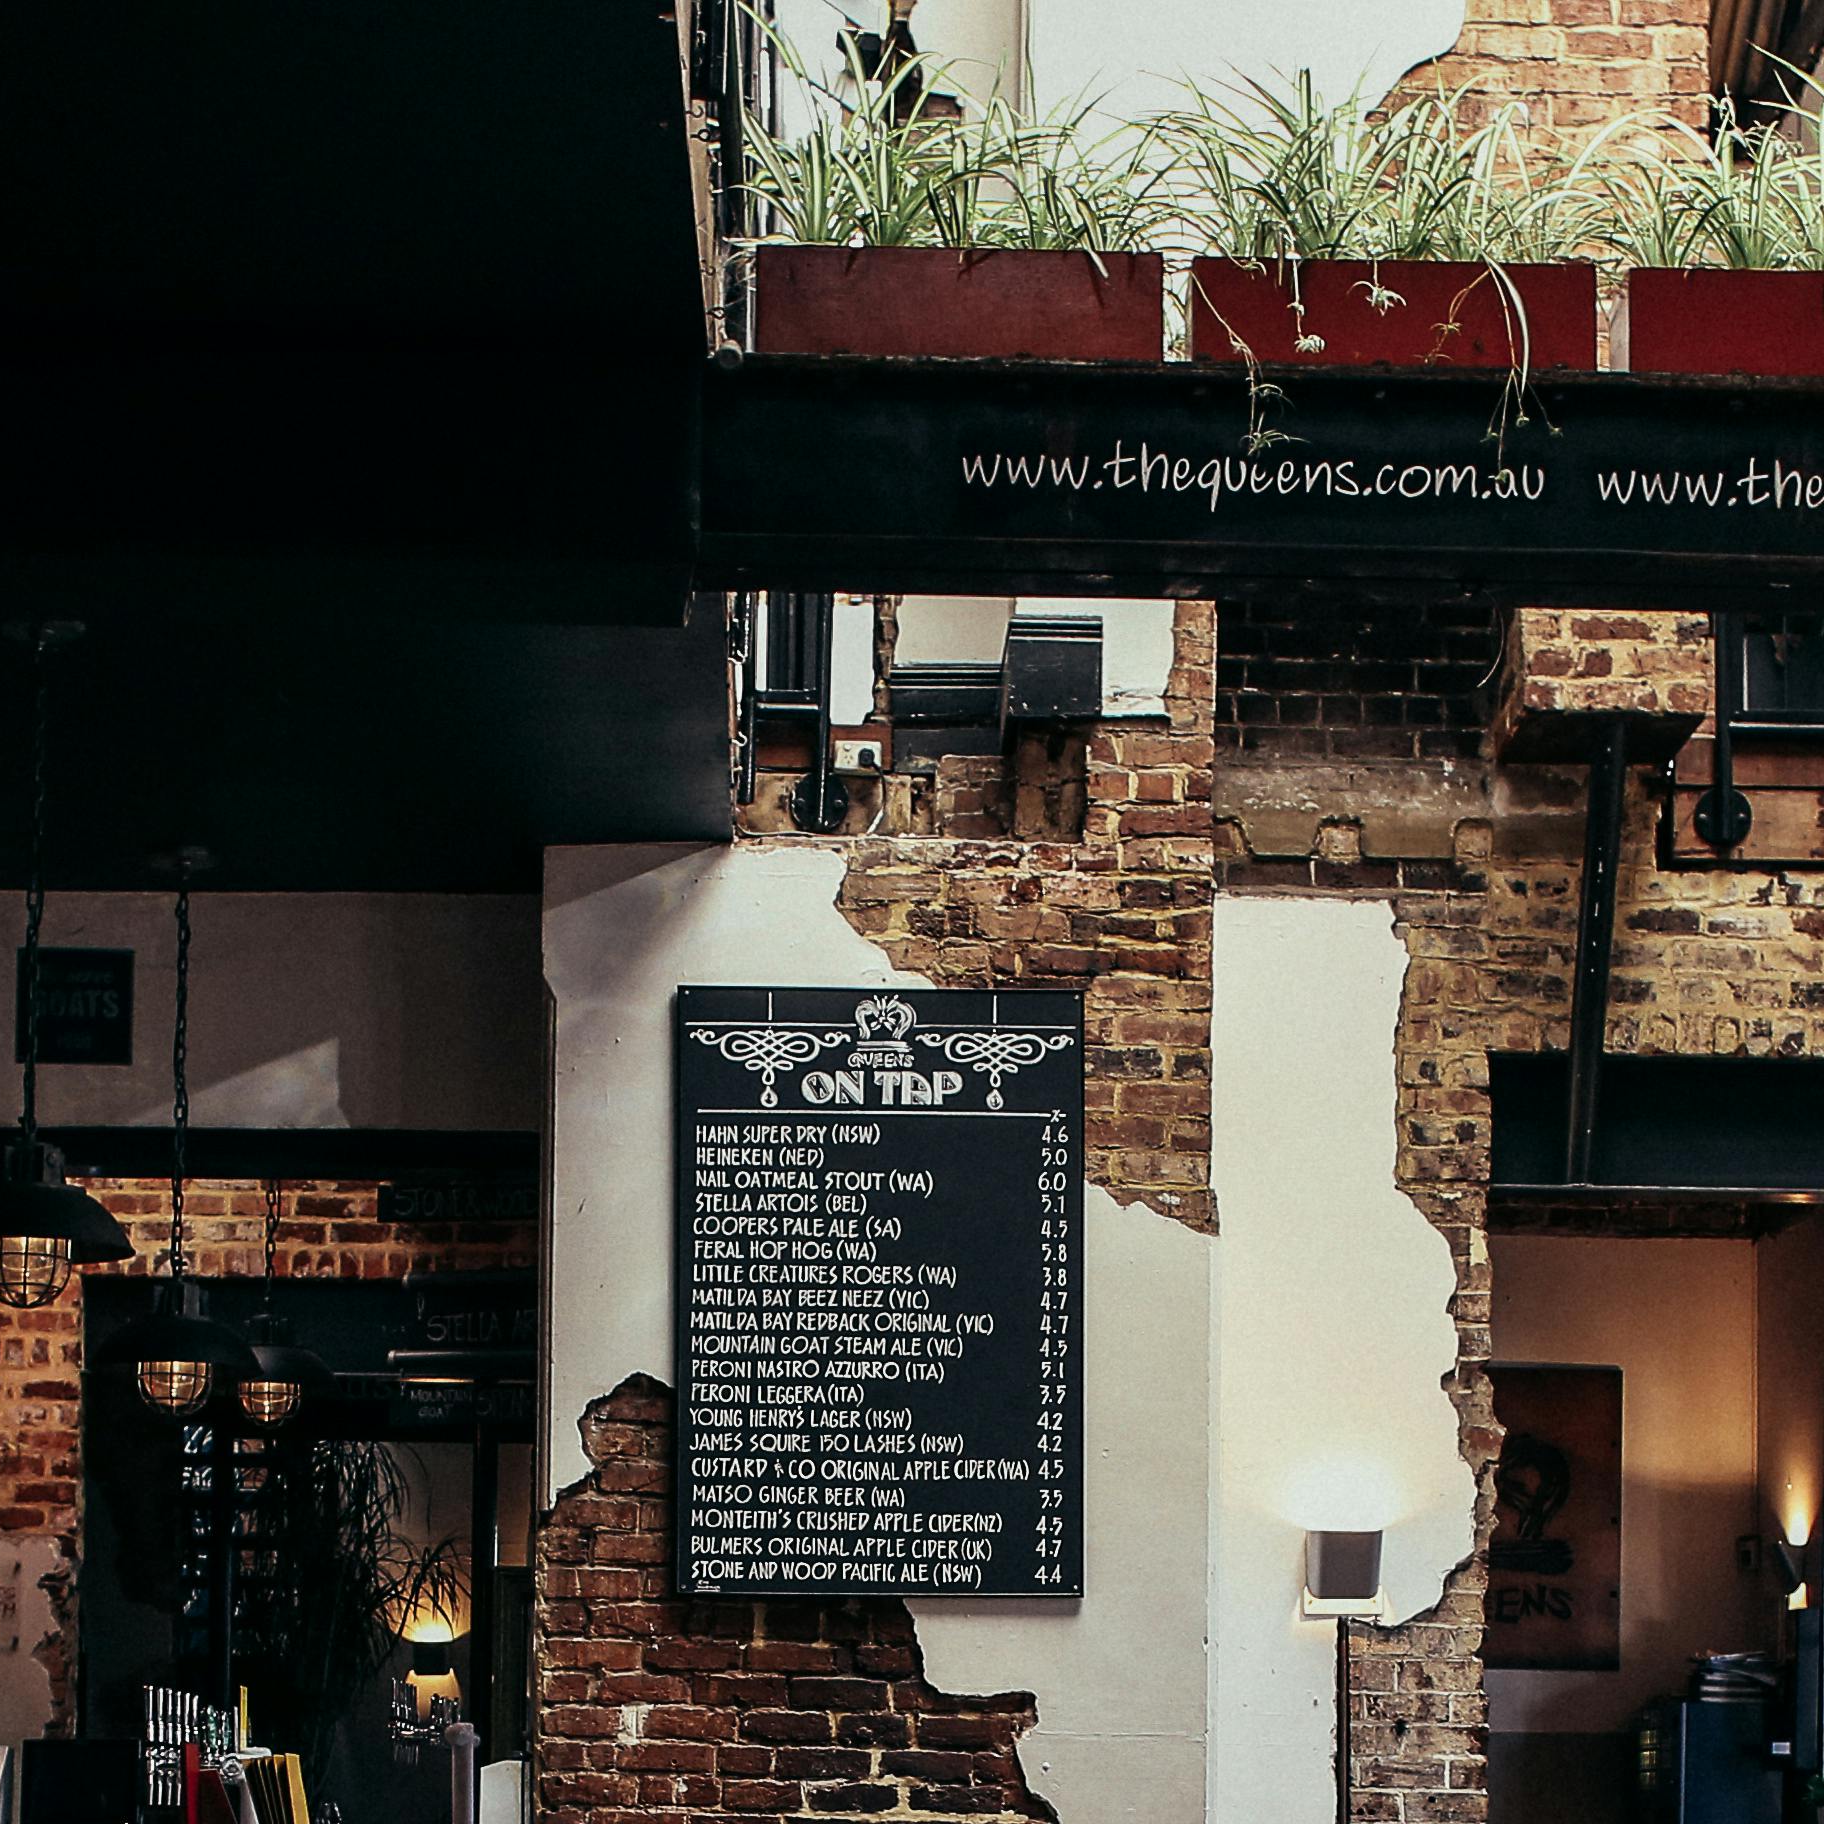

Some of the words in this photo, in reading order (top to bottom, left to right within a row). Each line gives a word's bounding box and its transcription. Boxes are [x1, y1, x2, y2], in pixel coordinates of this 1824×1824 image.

[962, 438, 1545, 513] www.thequeens.com.au
[847, 1052, 915, 1069] QUEENS
[801, 1070, 865, 1105] ON
[873, 1070, 964, 1106] TAP
[696, 1125, 738, 1144] HAHN
[743, 1125, 792, 1144] SUPER
[797, 1126, 827, 1144] DRY
[832, 1123, 880, 1145] (NSW)
[1042, 1126, 1068, 1143] 4.6
[697, 1147, 773, 1166] HEINEKEN
[779, 1147, 824, 1168] (NED)
[1042, 1148, 1067, 1166] 5.0
[696, 1170, 730, 1187] NAIL
[735, 1171, 818, 1190] OATMEAL
[825, 1172, 885, 1190] STOUT
[889, 1169, 933, 1198] (WA)
[1038, 1172, 1066, 1191] 6.0
[696, 1193, 752, 1212] STELLA
[757, 1193, 818, 1212] ARTOIS
[826, 1193, 866, 1216] (BEL)
[1042, 1194, 1064, 1213] 5.1
[694, 1216, 778, 1236] COOPERS
[783, 1218, 824, 1237] PALE
[828, 1219, 859, 1238] ALE
[866, 1216, 901, 1240] (SA)
[1041, 1220, 1067, 1238] 4.5
[695, 1240, 744, 1259] FERAL
[750, 1240, 788, 1260] HOP
[792, 1241, 832, 1259] HOG
[837, 1240, 876, 1262] (WA)
[1042, 1244, 1067, 1262] 5.8
[694, 1264, 744, 1283] LITTLE
[749, 1265, 837, 1284] CREATURES
[843, 1266, 913, 1285] ROGERS
[918, 1264, 956, 1288] (WA)
[1043, 1267, 1066, 1286] 3.8
[692, 1288, 757, 1306] MATILDA
[763, 1289, 792, 1307] BAY
[799, 1290, 838, 1306] BEEZ
[843, 1290, 883, 1307] NEEZ
[889, 1288, 929, 1310] (VIC)
[1041, 1292, 1067, 1310] 4.7
[427, 1312, 502, 1344] STELLA
[691, 1312, 758, 1330] MATILDA
[763, 1312, 793, 1330] BAY
[797, 1312, 870, 1332] REDBACK
[875, 1312, 951, 1333] ORIGINAL
[956, 1313, 993, 1335] (VIC)
[1040, 1314, 1068, 1334] 4.7
[692, 1335, 775, 1354] MOUNTAIN
[781, 1336, 829, 1354] GOAT
[834, 1336, 886, 1355] STEAM
[890, 1338, 921, 1356] ALE
[927, 1336, 962, 1358] (VIC)
[1040, 1338, 1067, 1357] 4.5
[692, 1360, 751, 1378] PERONI
[758, 1360, 819, 1378] NASTRO
[825, 1360, 899, 1379] AZZURRO
[906, 1362, 944, 1384] (ITA)
[1042, 1362, 1063, 1378] 5.1
[692, 1383, 750, 1403] PERONI
[758, 1386, 826, 1404] LEGGERA
[828, 1384, 864, 1407] (ITA)
[1040, 1385, 1066, 1404] 3.5
[690, 1408, 742, 1427] YOUNG
[811, 1410, 860, 1428] LAGER
[865, 1408, 911, 1431] (NSW)
[1037, 1411, 1062, 1430] 4.2
[690, 1433, 743, 1451] JAMES
[750, 1434, 811, 1452] SQUIRE
[820, 1434, 849, 1452] 150
[854, 1434, 915, 1453] LASHES
[921, 1433, 963, 1456] (NSW)
[1037, 1434, 1062, 1452] 4.2
[692, 1458, 767, 1477] CUSTARD
[789, 1459, 815, 1479] CO
[821, 1460, 899, 1481] ORIGINAL
[903, 1461, 950, 1480] APPLE
[954, 1460, 995, 1479] CIDER
[998, 1458, 1029, 1480] (WA)
[1038, 1460, 1063, 1480] 4.5
[693, 1485, 752, 1503] MATSO
[759, 1486, 818, 1504] GINGER
[825, 1488, 865, 1506] BEER
[871, 1486, 904, 1507] (WA)
[1040, 1490, 1062, 1509] 3.5
[692, 1509, 791, 1529] MONTEITH'S
[797, 1511, 869, 1530] CRUSHED
[874, 1513, 923, 1532] APPLE
[929, 1514, 973, 1533] CIDER
[972, 1513, 1002, 1532] (NZ)
[1036, 1516, 1062, 1535] 4.5
[692, 1536, 762, 1555] BULMERS
[768, 1537, 849, 1556] ORIGINAL
[853, 1538, 906, 1557] APPLE
[912, 1540, 958, 1559] CIDER
[961, 1538, 992, 1561] (UK)
[1036, 1539, 1061, 1557] 4.7
[692, 1560, 744, 1580] STONE
[749, 1562, 777, 1580] AND
[781, 1562, 836, 1580] WOOD
[843, 1563, 895, 1582] PACIFIC
[901, 1563, 928, 1582] ALE
[933, 1563, 981, 1589] (NSW)
[1035, 1564, 1061, 1584] 4.4
[1486, 1584, 1573, 1624] ENS
